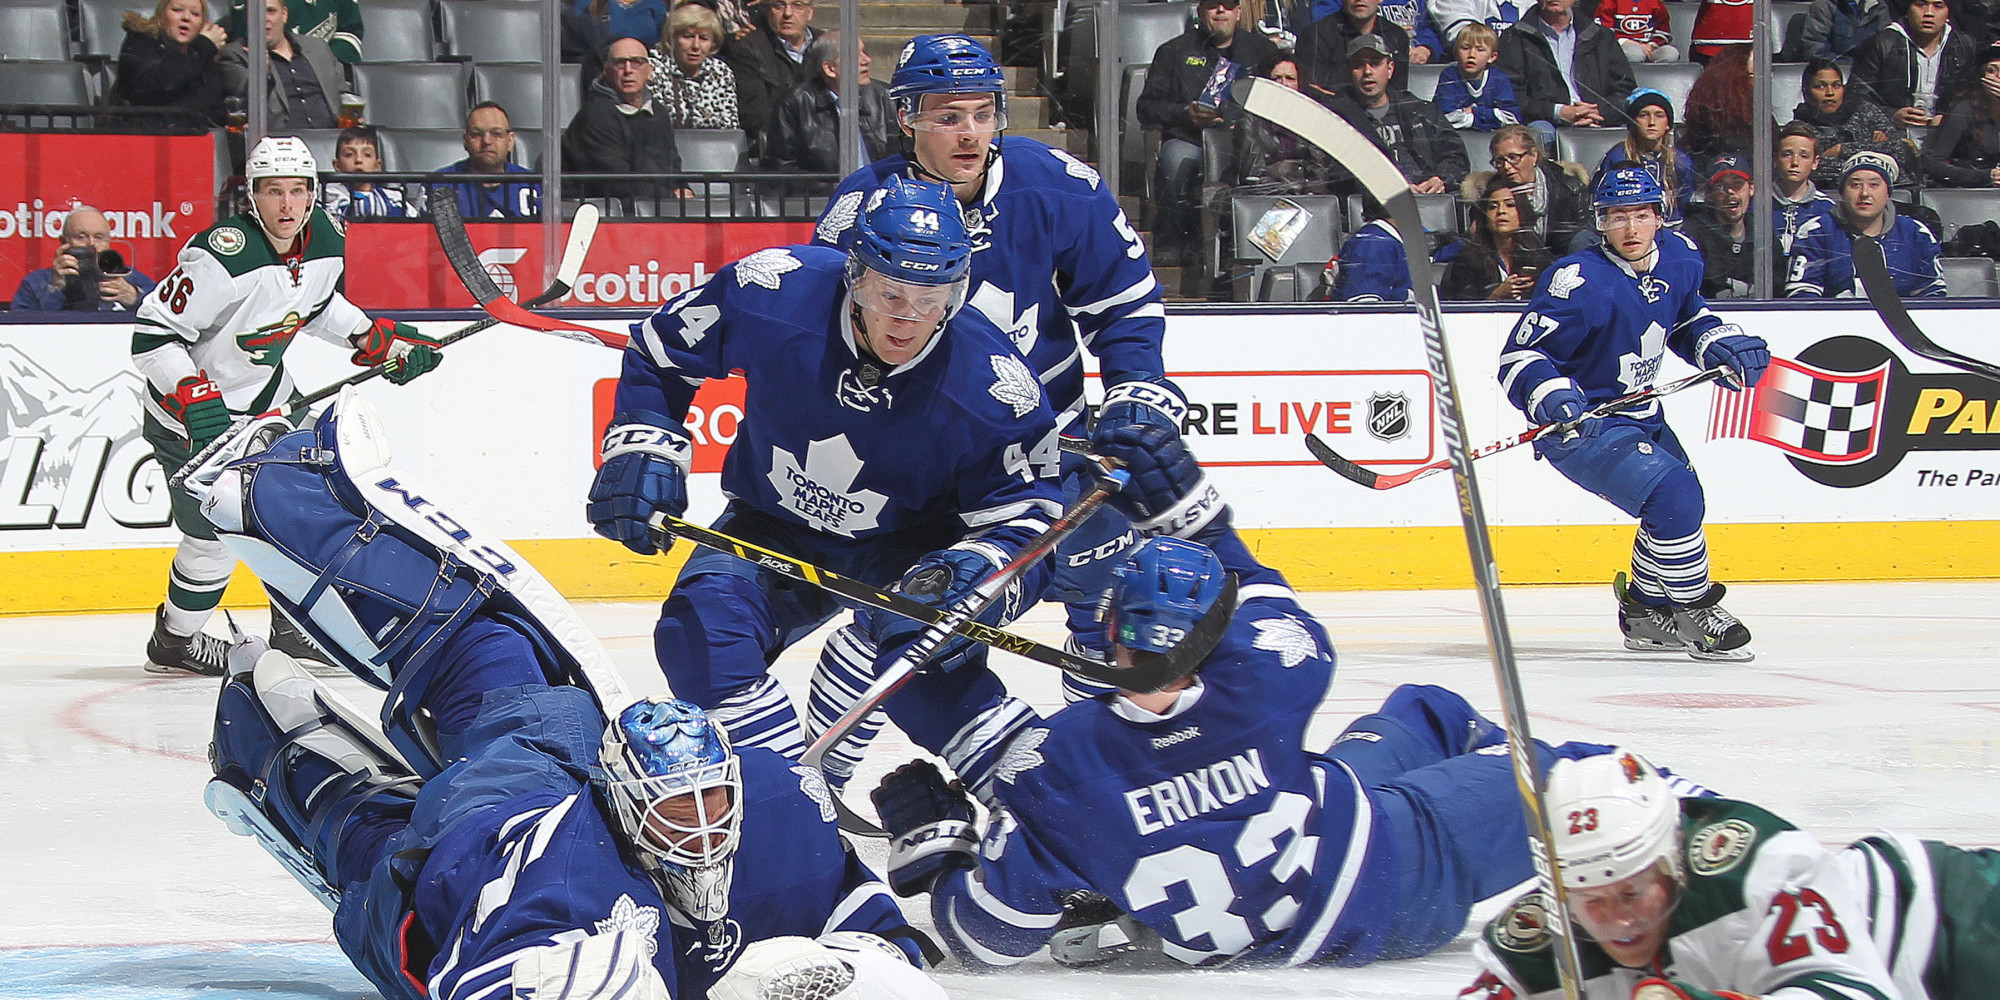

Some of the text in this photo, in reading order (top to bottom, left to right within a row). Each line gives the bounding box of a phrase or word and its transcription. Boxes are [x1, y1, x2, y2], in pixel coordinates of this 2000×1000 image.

[952, 68, 986, 76] CCM
[0, 198, 177, 239] otiaank
[910, 209, 939, 230] 44
[560, 260, 716, 303] cotia
[900, 260, 939, 272] CCM
[1515, 311, 1560, 347] 67
[1253, 402, 1352, 435] LIVE
[1376, 405, 1403, 431] NHL
[604, 430, 688, 453] CCM
[1003, 427, 1061, 483] 44
[786, 466, 865, 514] TORONTO
[1917, 470, 1958, 487] The
[793, 486, 847, 521] MAPLE
[795, 499, 841, 528] LEAFS
[1068, 529, 1134, 567] CCM
[1151, 725, 1202, 750] Reebok
[1122, 748, 1271, 837] ERIXON
[1568, 807, 1599, 835] 23
[1121, 791, 1320, 966] 33
[1766, 887, 1850, 967] 23
